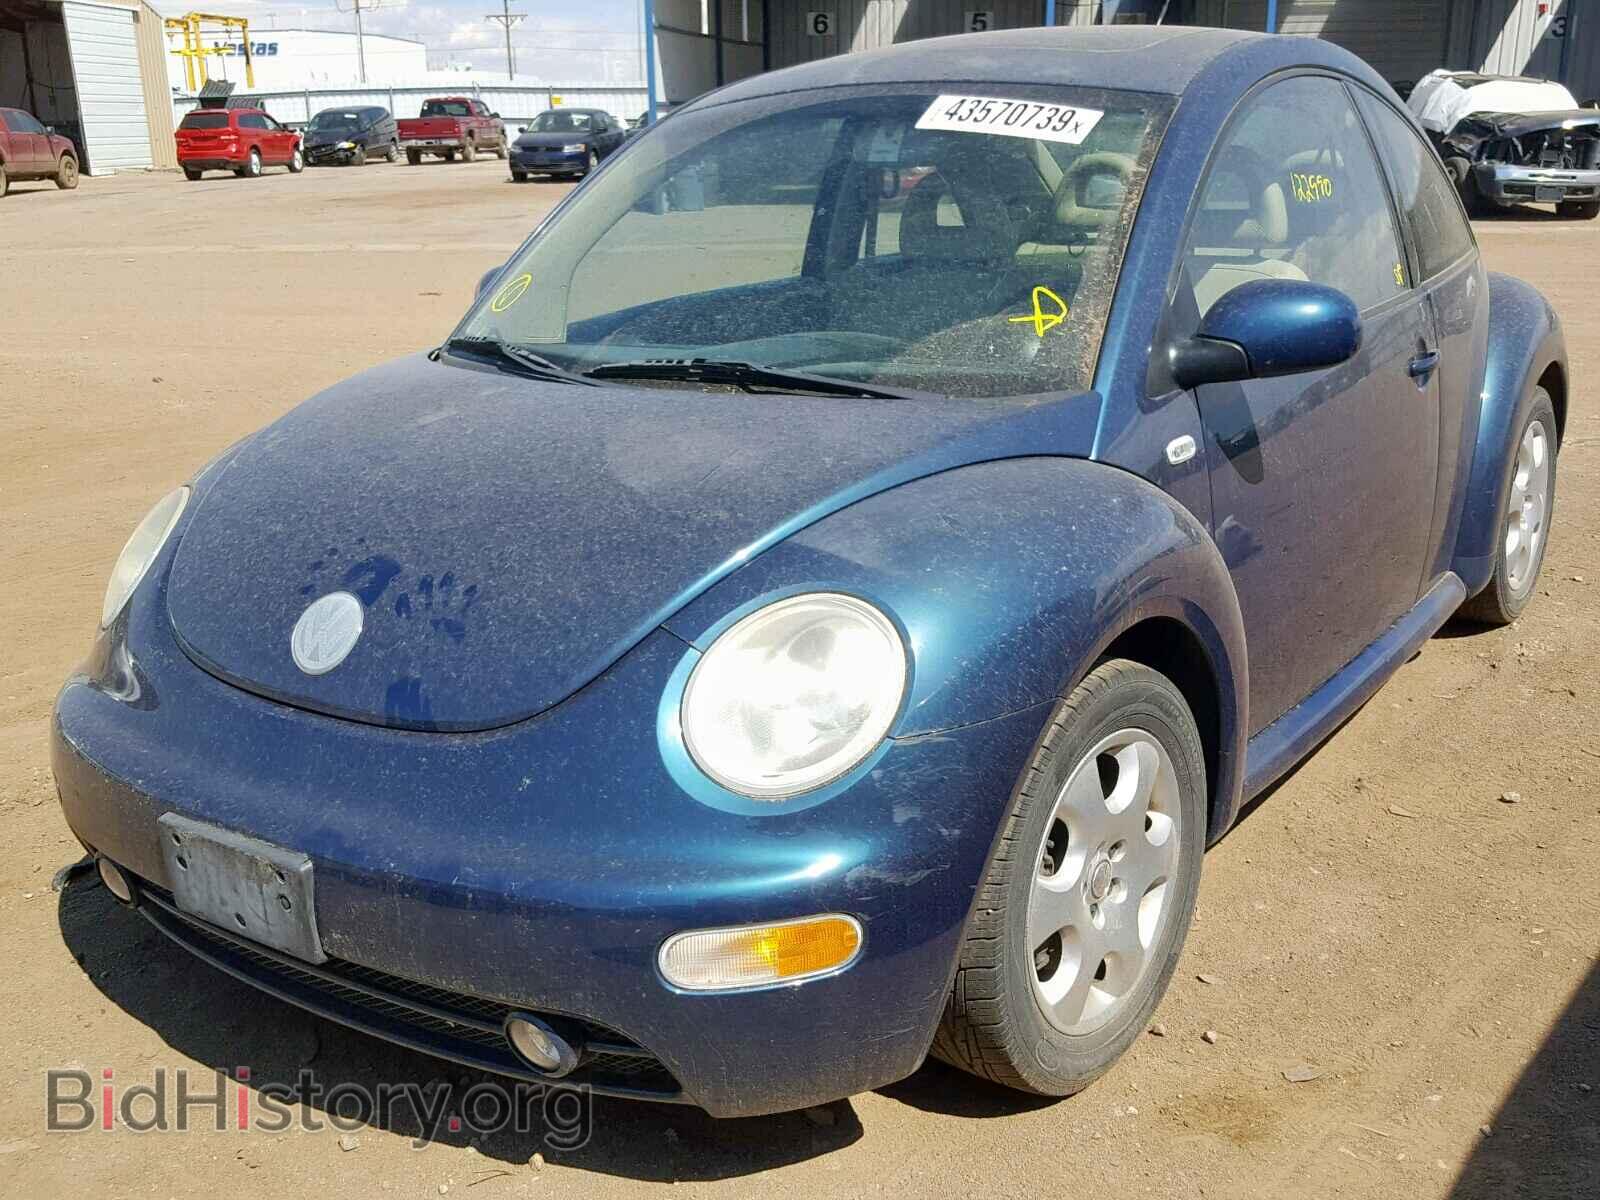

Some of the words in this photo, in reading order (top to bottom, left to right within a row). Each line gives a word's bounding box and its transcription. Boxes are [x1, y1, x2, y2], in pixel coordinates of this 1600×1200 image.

[813, 13, 828, 34] 6
[971, 12, 988, 32] 5
[1551, 16, 1567, 38] 3
